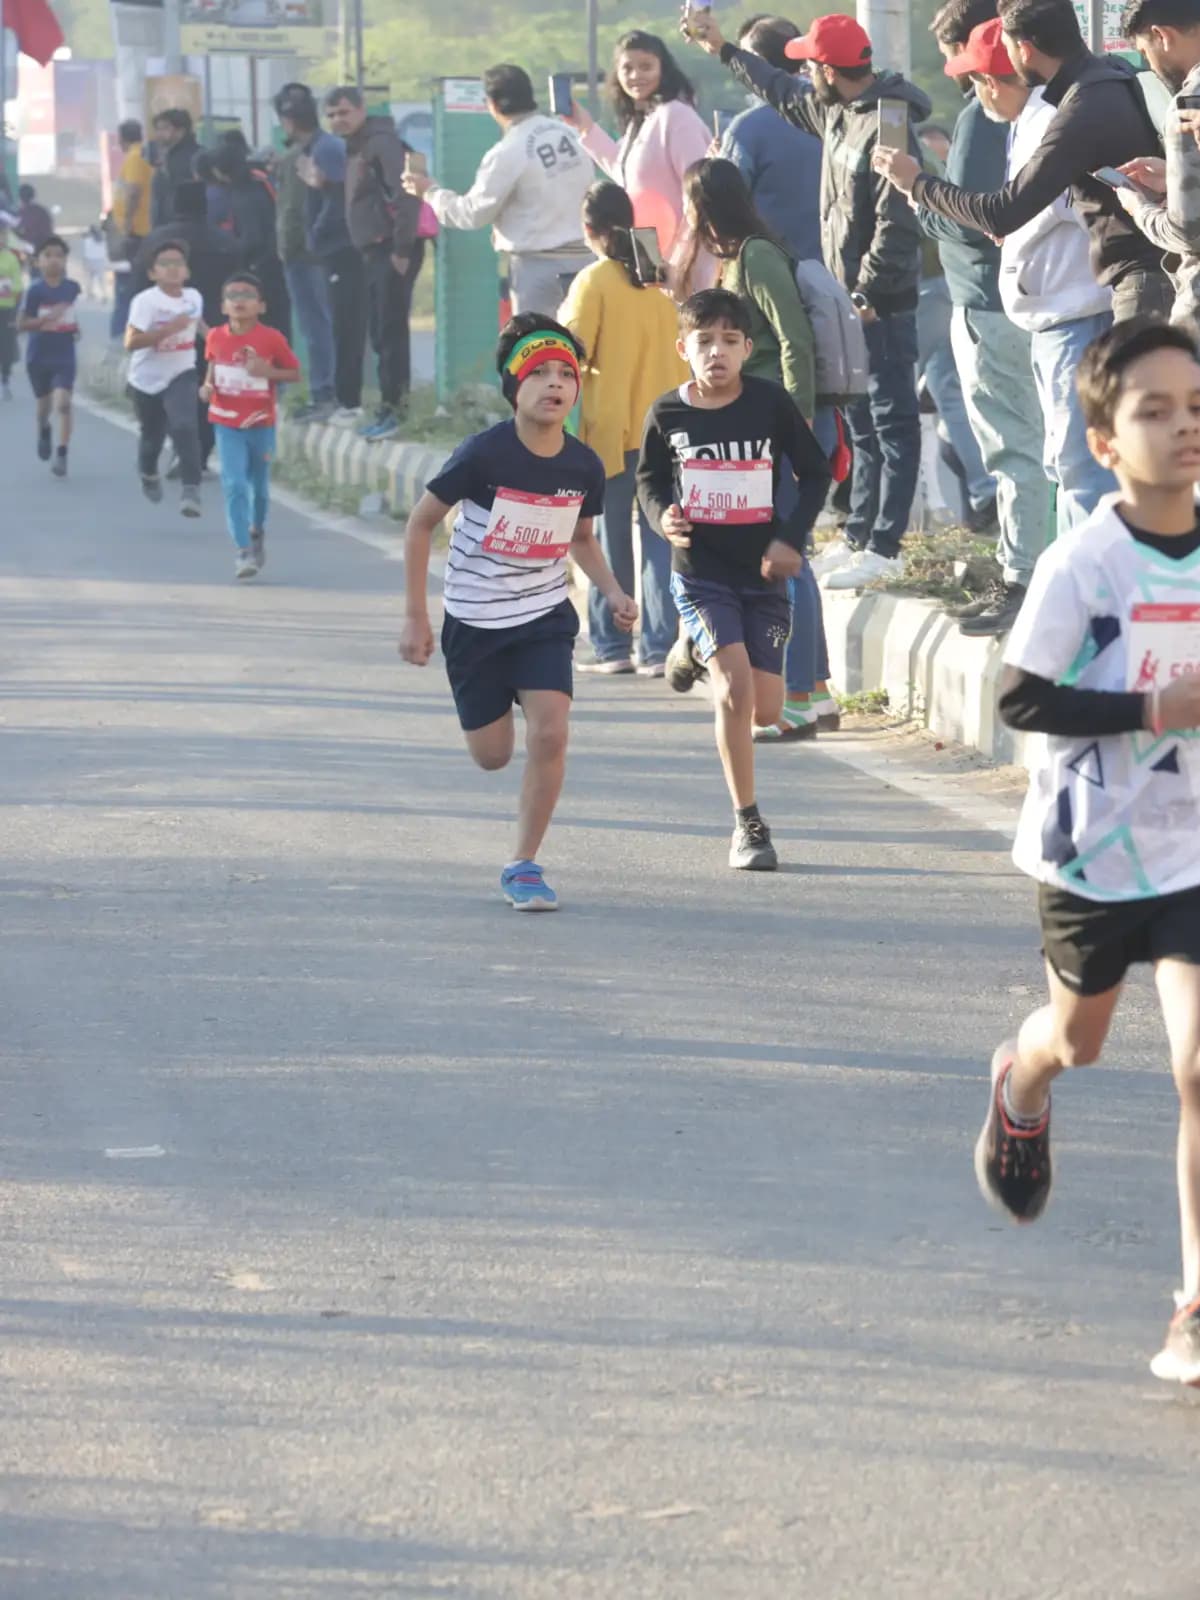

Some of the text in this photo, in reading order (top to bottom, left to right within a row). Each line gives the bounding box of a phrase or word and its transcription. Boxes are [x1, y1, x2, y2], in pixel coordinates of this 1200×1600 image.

[536, 135, 577, 168] 84
[707, 491, 748, 509] 500 M
[513, 526, 554, 545] 500 M
